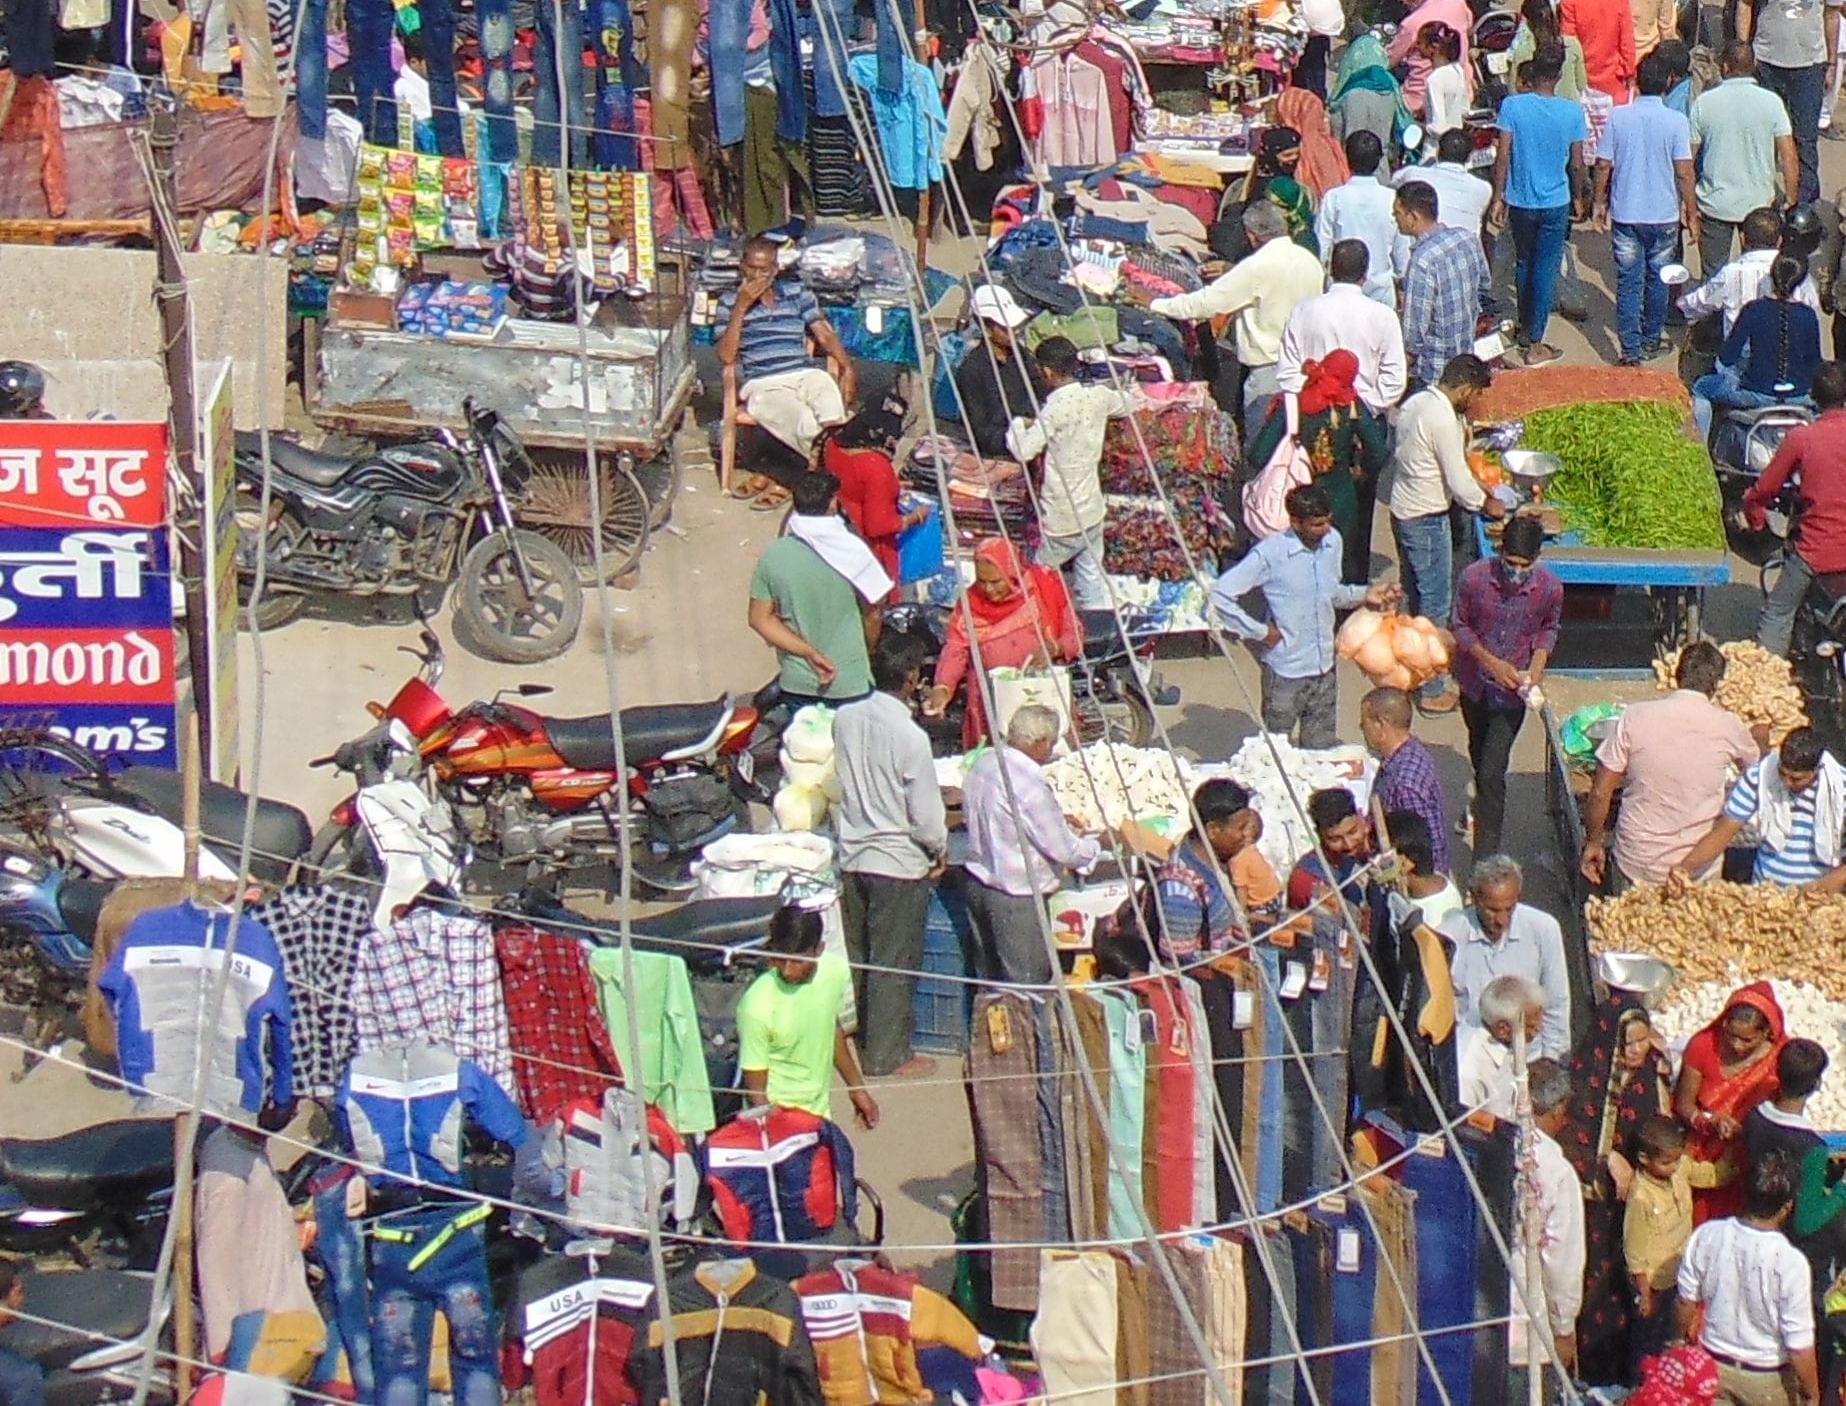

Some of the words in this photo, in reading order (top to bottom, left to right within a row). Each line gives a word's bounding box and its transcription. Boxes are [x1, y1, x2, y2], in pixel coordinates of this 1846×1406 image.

[55, 447, 150, 521] सूट
[0, 631, 162, 688] mond
[227, 958, 252, 981] SA
[549, 1288, 585, 1315] USA
